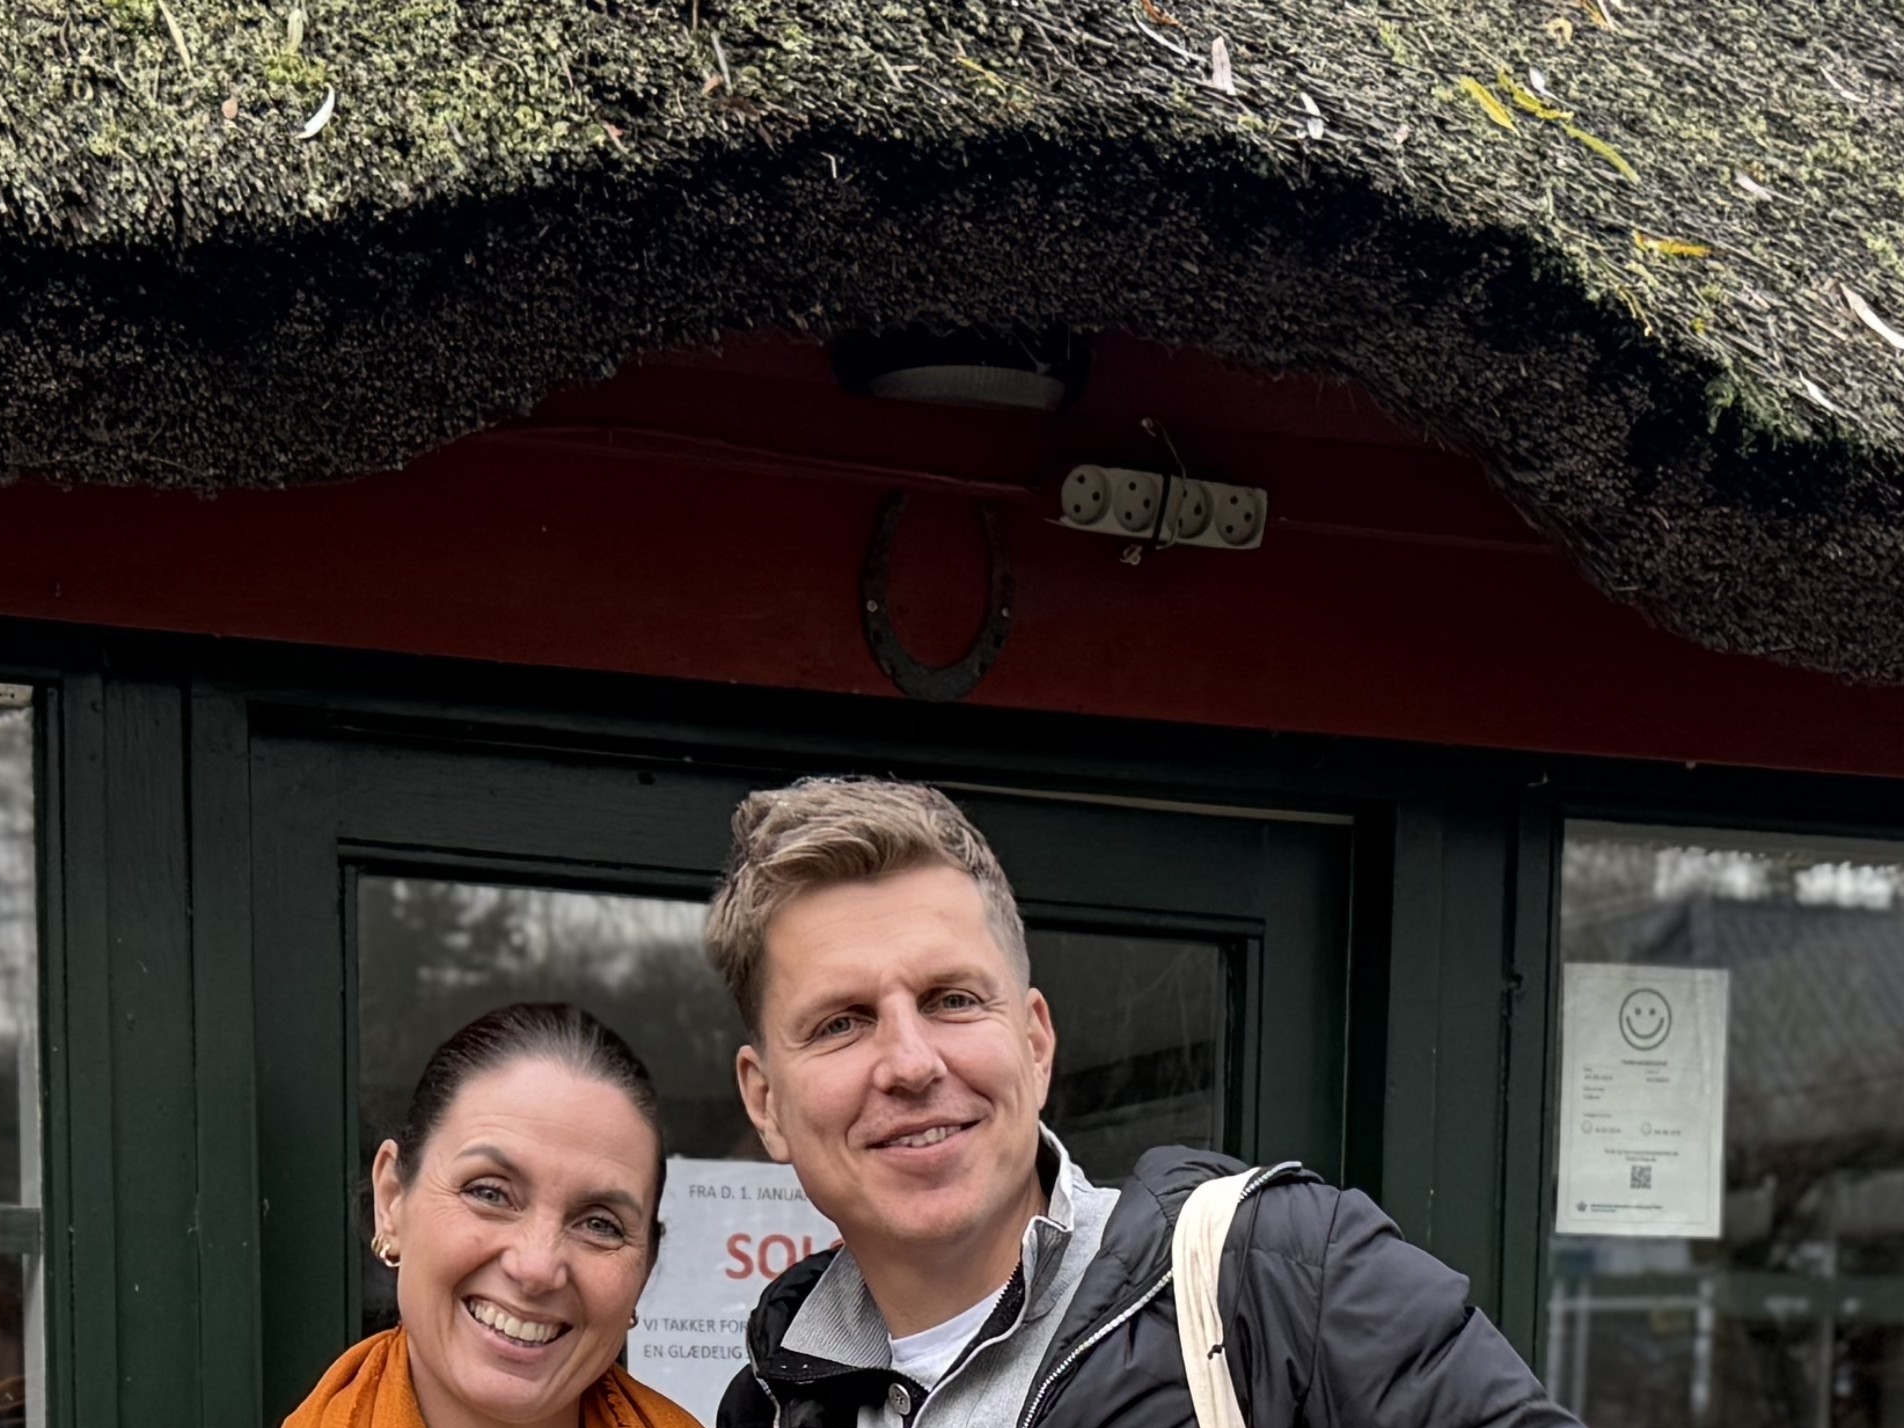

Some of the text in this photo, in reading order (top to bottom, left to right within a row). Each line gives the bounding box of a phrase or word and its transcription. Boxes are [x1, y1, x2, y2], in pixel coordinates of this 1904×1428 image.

[689, 1184, 808, 1202] FRA D. 1. JANUA
[643, 1319, 658, 1332] VI
[662, 1318, 716, 1333] TAKKER
[643, 1344, 743, 1360] EN GLÆDELIG
